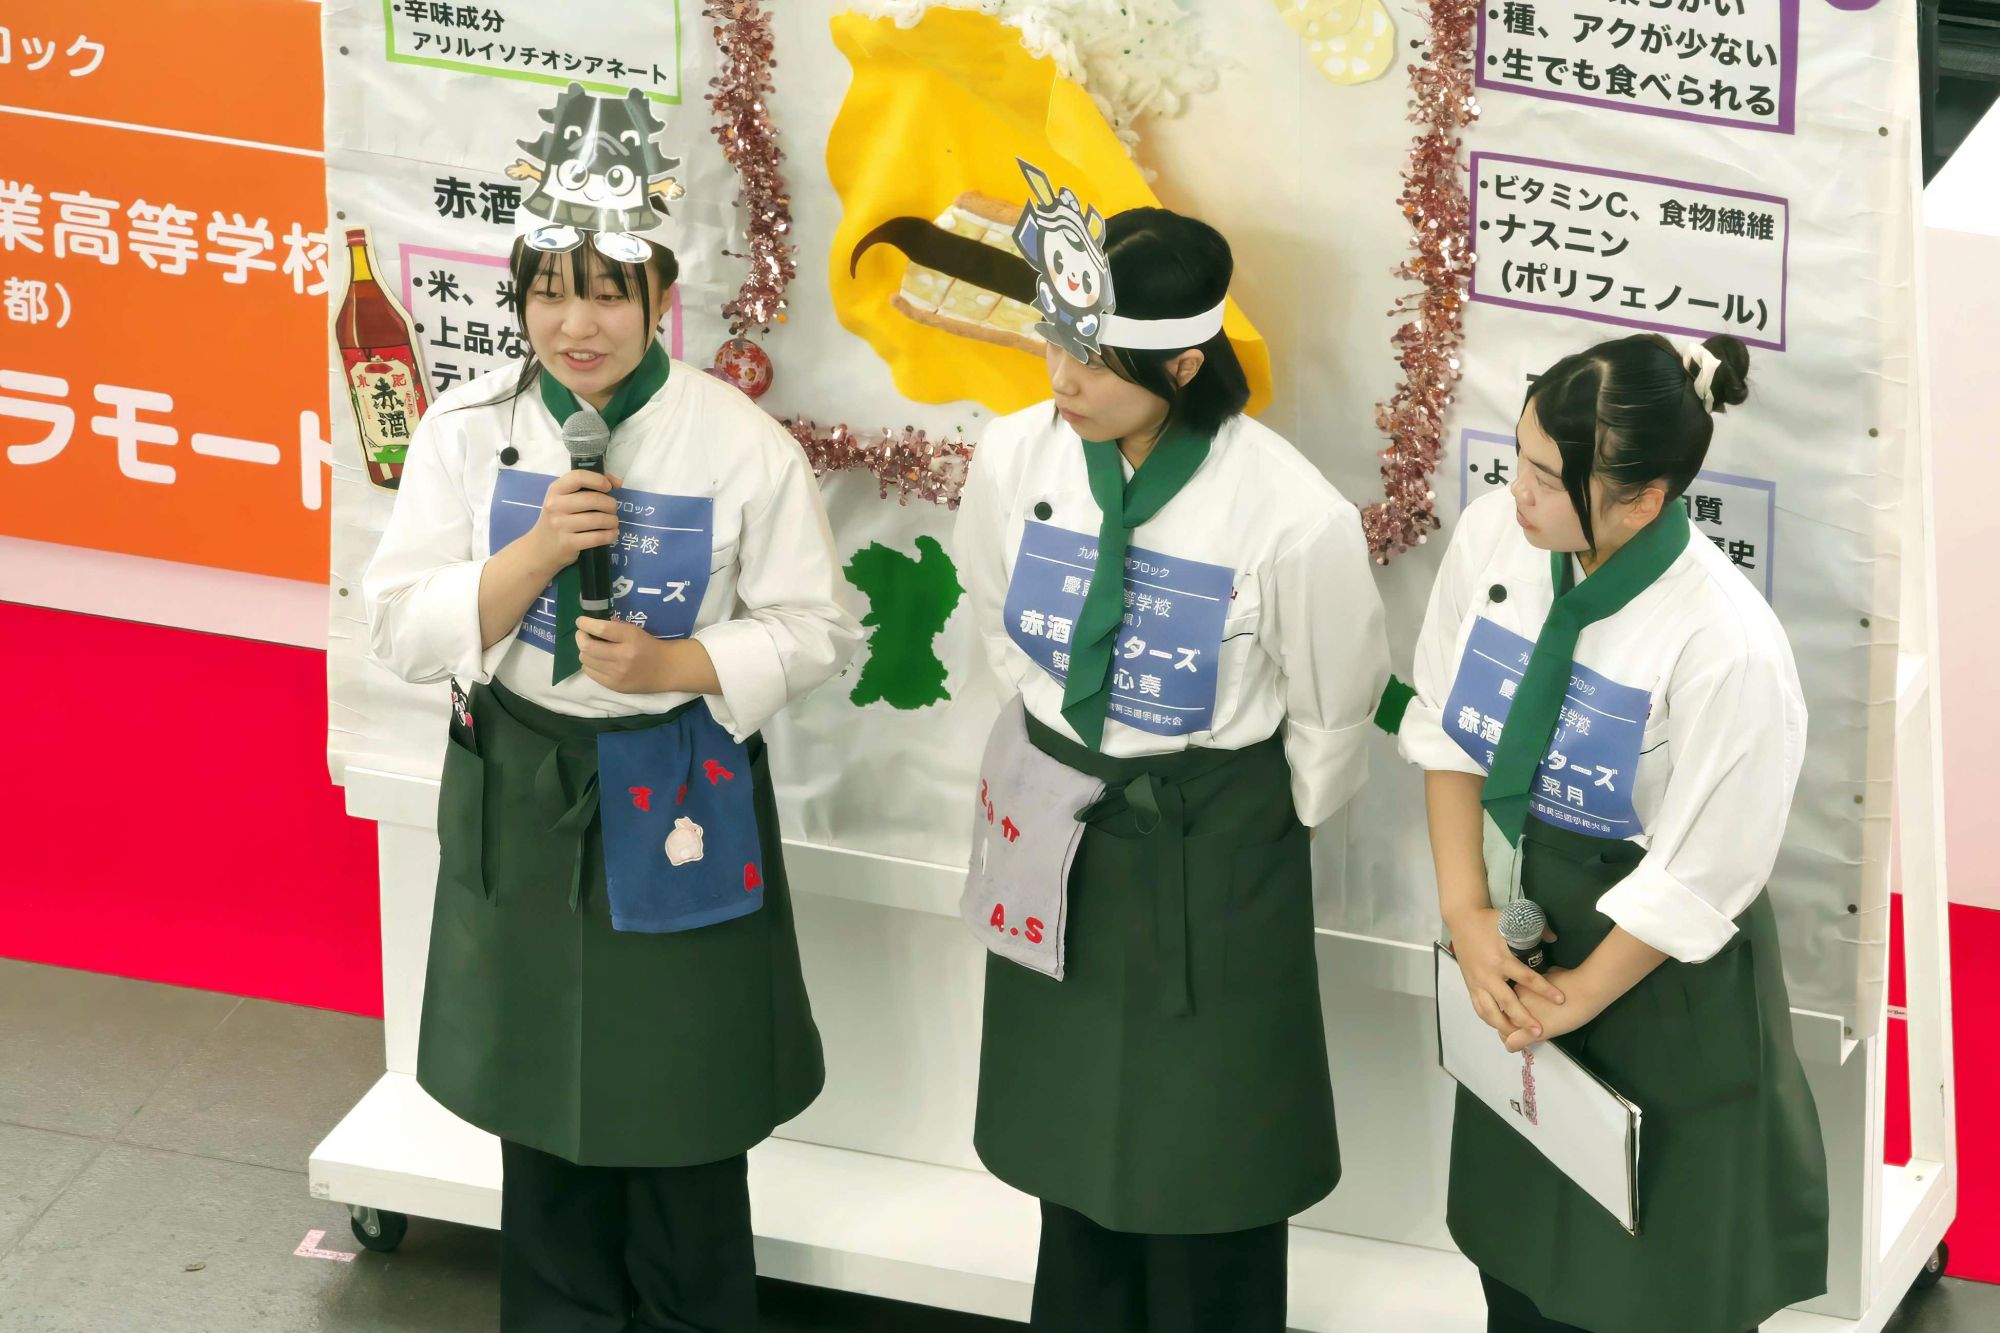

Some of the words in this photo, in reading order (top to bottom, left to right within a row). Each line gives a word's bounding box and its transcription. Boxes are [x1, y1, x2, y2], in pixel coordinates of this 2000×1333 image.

[412, 31, 669, 86] アリルイソチオシアネート
[433, 176, 522, 225] 赤酒
[0, 179, 329, 297] 業高等学校
[616, 531, 660, 555] 学校
[1019, 608, 1073, 645] 赤酒
[1113, 633, 1201, 674] ターズ
[1458, 705, 1504, 745] 赤酒
